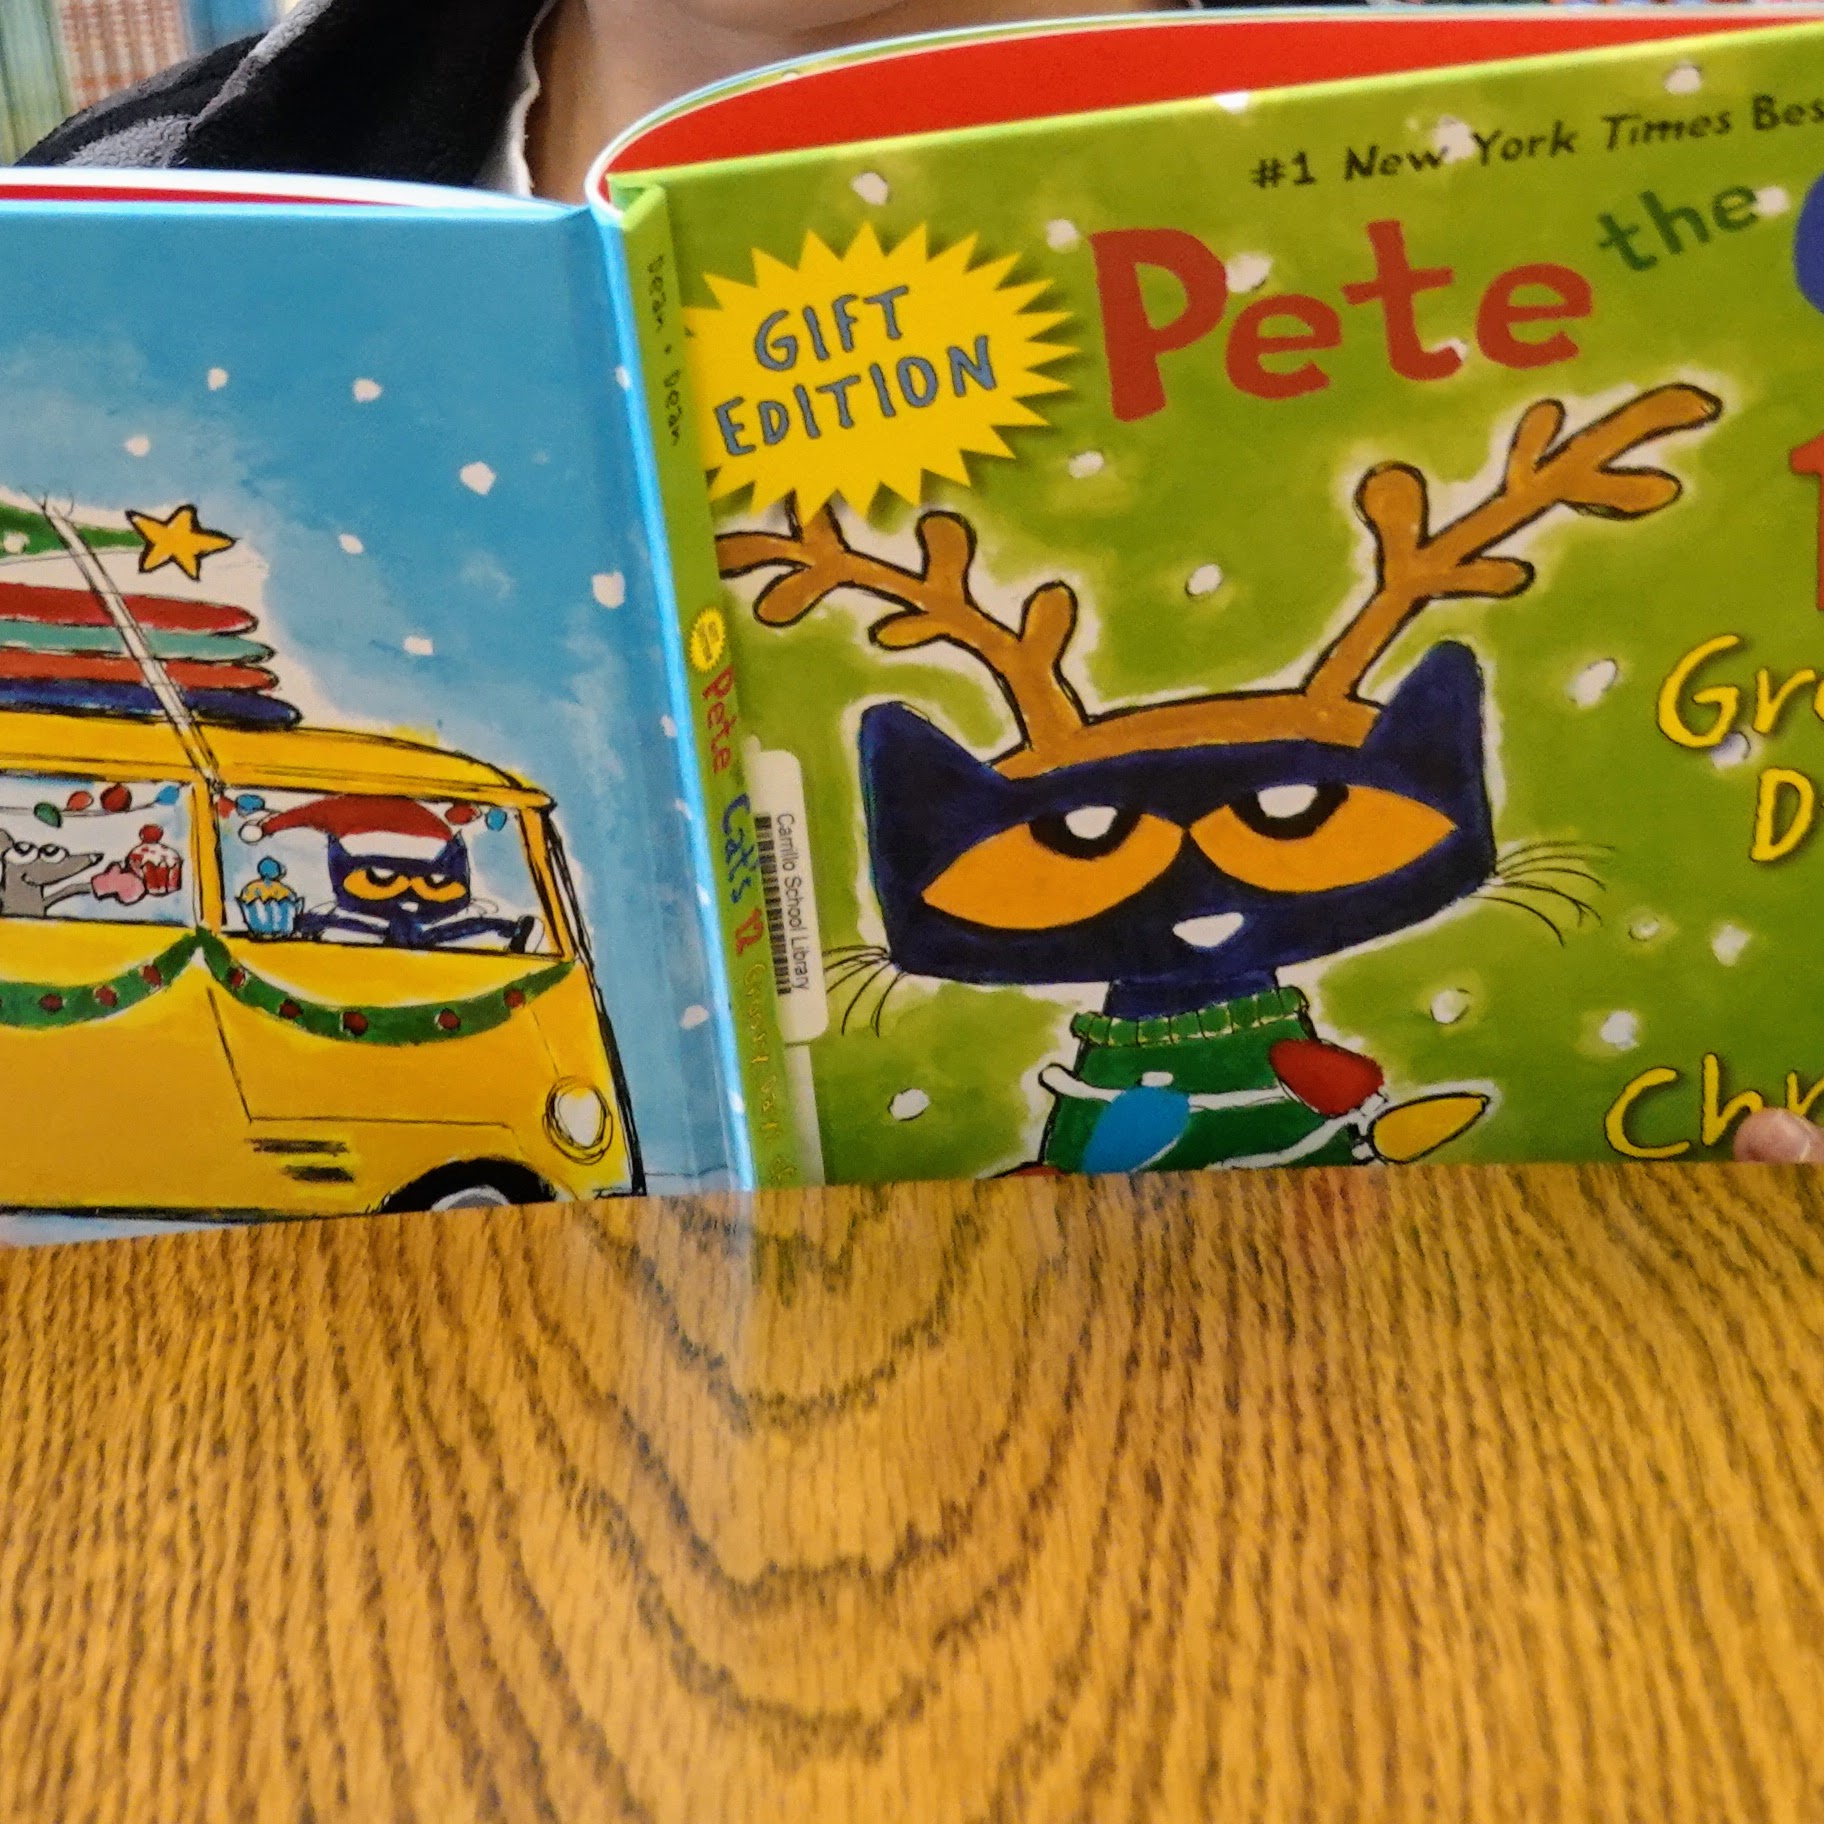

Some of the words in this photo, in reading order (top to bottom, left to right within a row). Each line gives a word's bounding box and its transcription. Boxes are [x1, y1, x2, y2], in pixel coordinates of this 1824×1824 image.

[1251, 154, 1316, 189] #1
[1344, 144, 1450, 181] New
[1471, 126, 1576, 165] York
[1601, 109, 1732, 152] Times
[753, 284, 910, 372] GIFT
[1089, 218, 1593, 423] Pete
[1596, 184, 1759, 274] the
[713, 335, 998, 457] EDITION
[701, 663, 734, 774] Pete
[784, 875, 808, 931] School
[790, 935, 810, 991] Library
